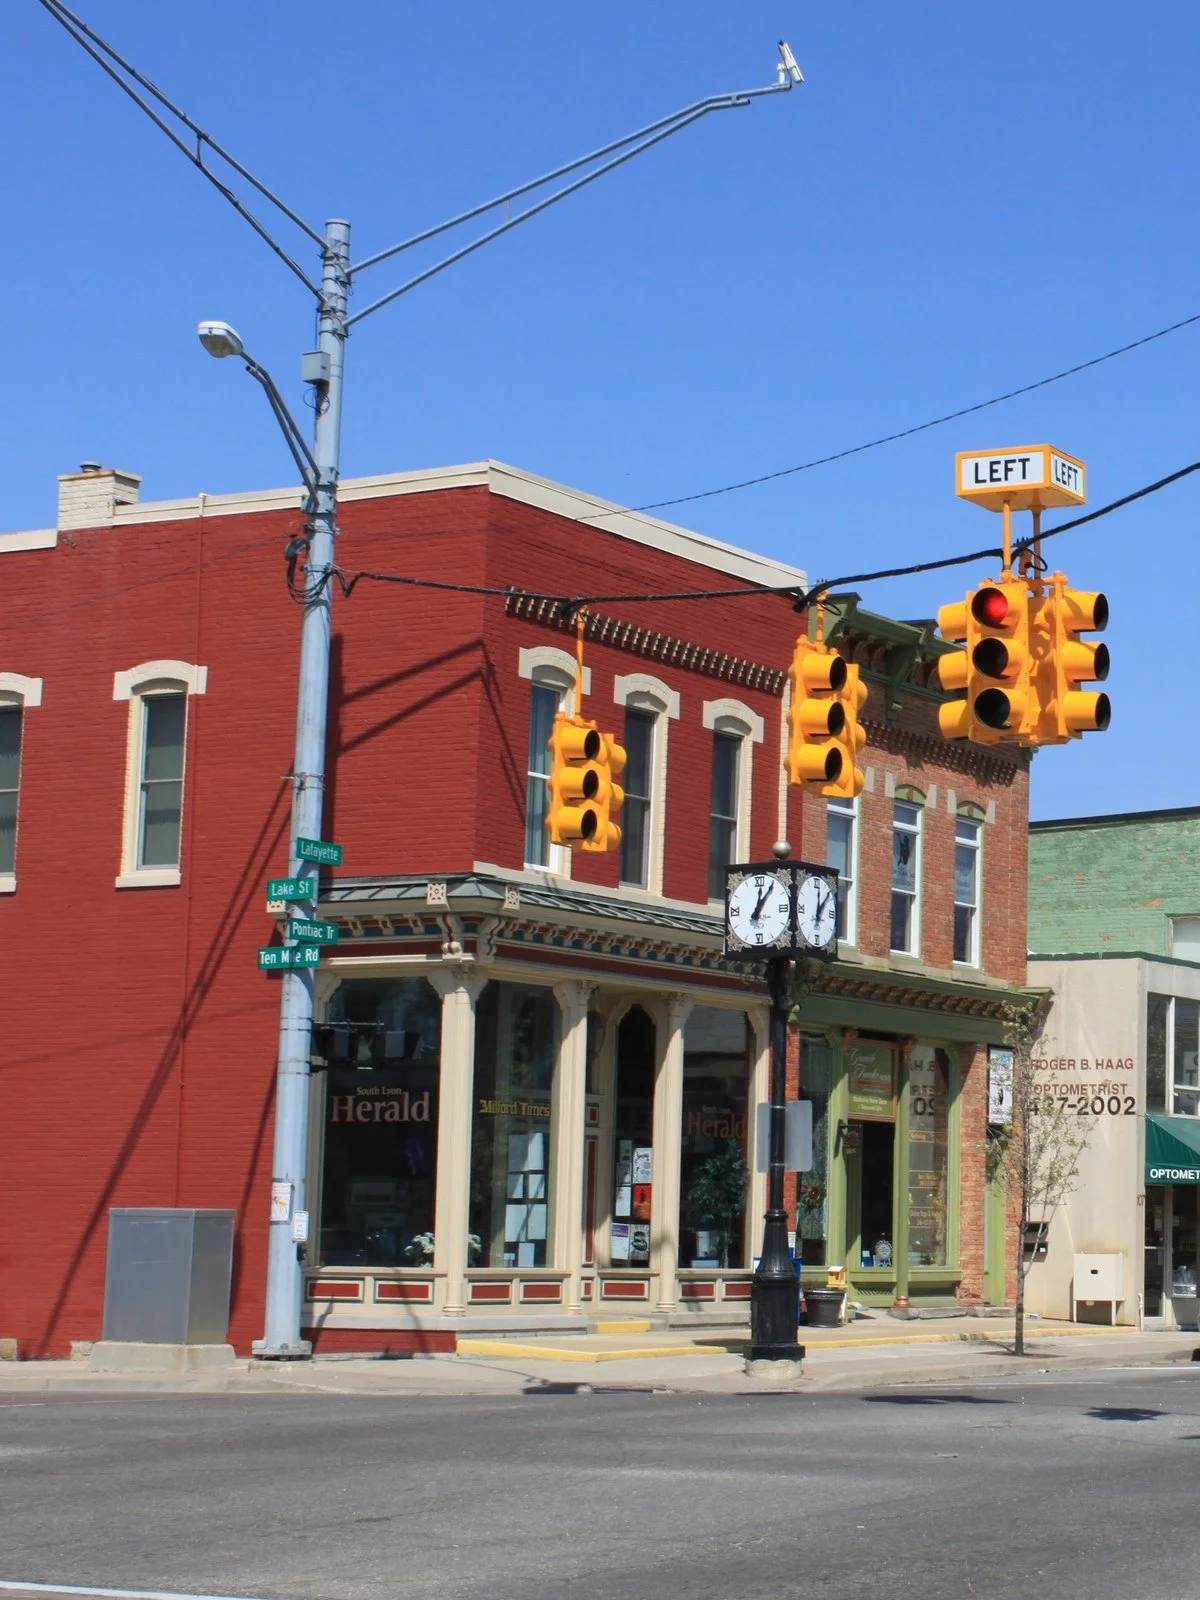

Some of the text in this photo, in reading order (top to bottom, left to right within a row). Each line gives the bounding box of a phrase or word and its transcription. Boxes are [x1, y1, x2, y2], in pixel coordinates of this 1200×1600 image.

[974, 458, 1030, 484] LEFT
[1055, 459, 1078, 490] LEFT
[301, 841, 339, 861] Lafayette
[271, 880, 310, 896] Lake St
[292, 921, 335, 939] Pontiac Tr
[260, 951, 276, 965] Ten
[305, 948, 319, 962] Rd
[1030, 1058, 1134, 1071] ROGER B. HAAG
[356, 1086, 402, 1097] South Lyon
[1033, 1083, 1129, 1096] OPTOMETRIST
[330, 1091, 430, 1123] Herald
[687, 1110, 746, 1139] Herald
